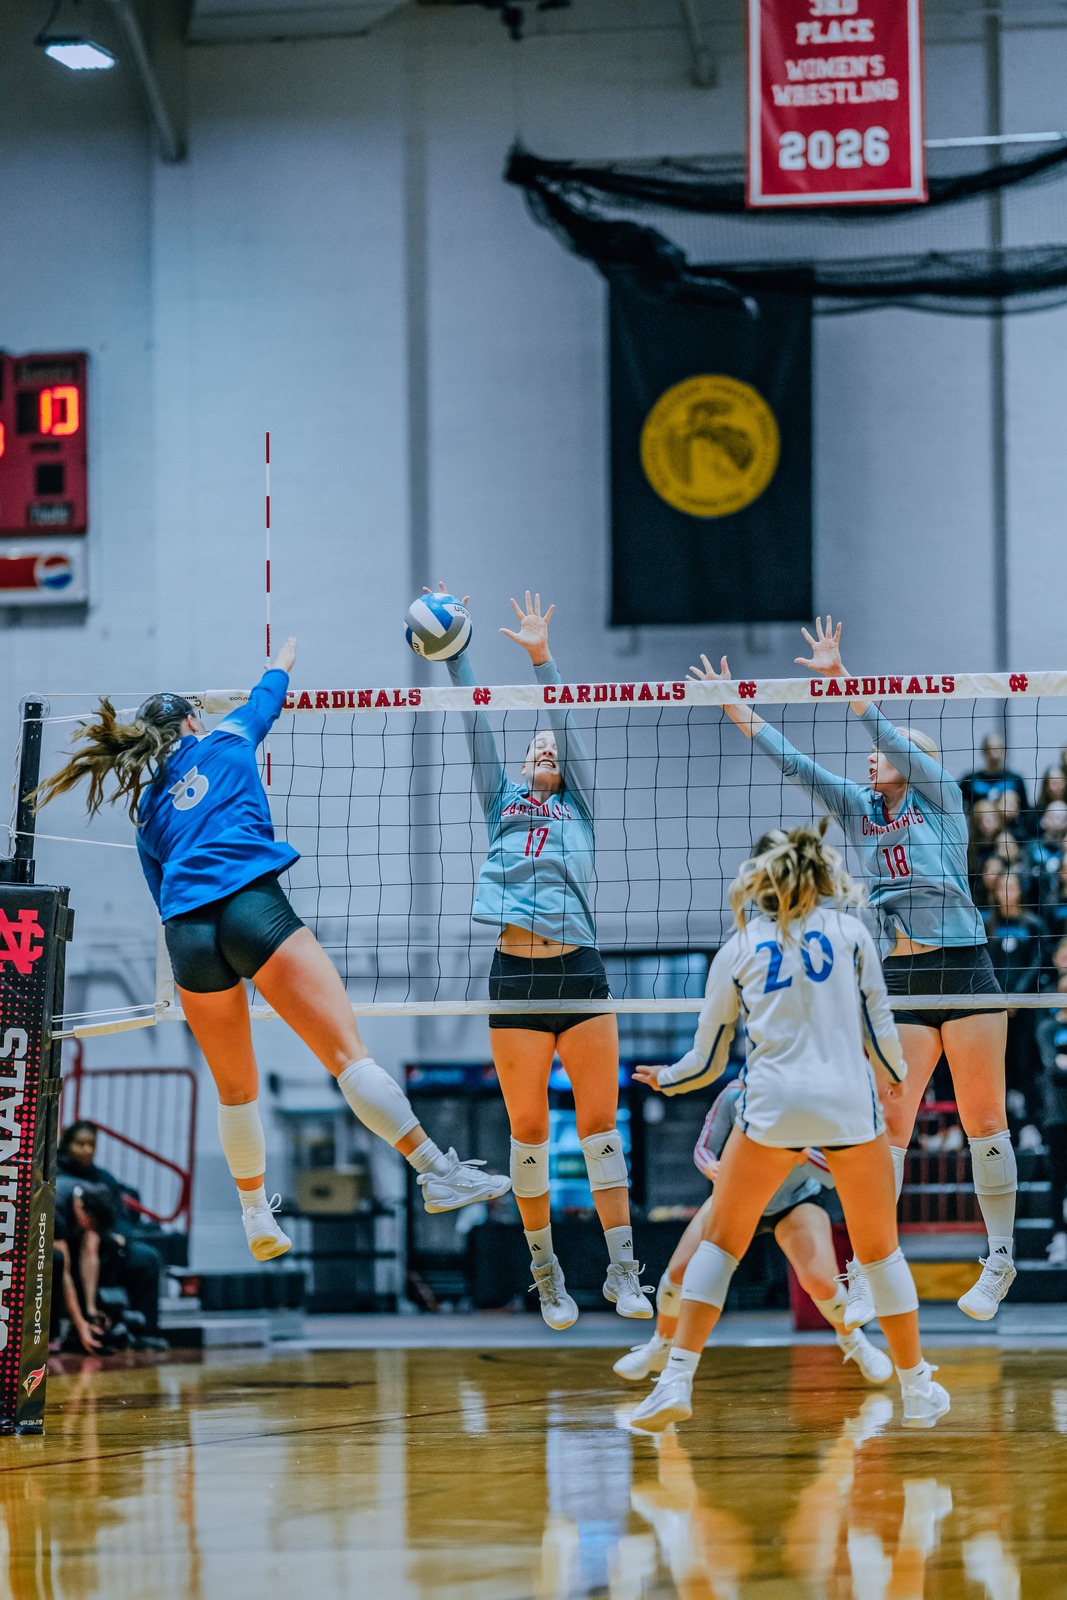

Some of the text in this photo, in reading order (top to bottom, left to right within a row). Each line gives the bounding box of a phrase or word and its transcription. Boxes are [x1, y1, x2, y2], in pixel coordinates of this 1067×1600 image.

[796, 19, 875, 44] PLACE
[785, 55, 885, 81] WOMEN'S
[772, 79, 899, 107] WRESTLING
[779, 126, 890, 170] 2026
[281, 688, 421, 709] CARDINALS
[543, 683, 686, 704] CARDINALS
[810, 675, 955, 697] CARDINALS
[524, 827, 549, 858] 17
[882, 844, 911, 880] 18
[755, 930, 834, 994] 20
[33, 1212, 47, 1345] sports imports
